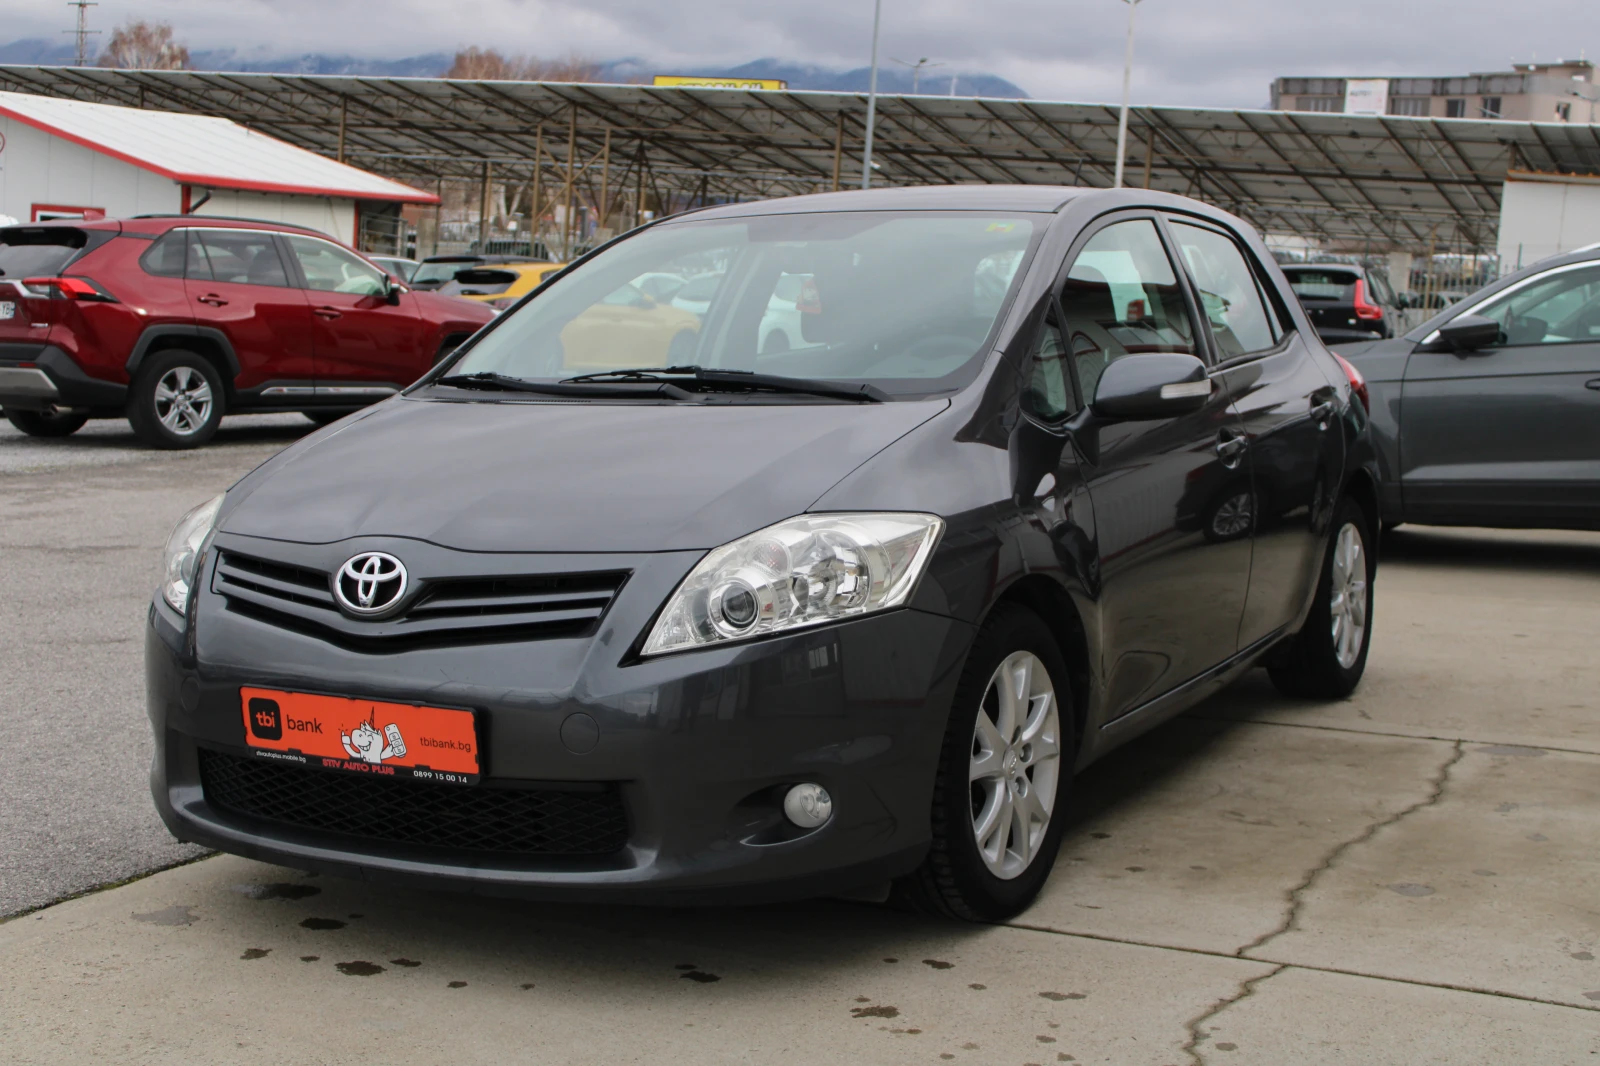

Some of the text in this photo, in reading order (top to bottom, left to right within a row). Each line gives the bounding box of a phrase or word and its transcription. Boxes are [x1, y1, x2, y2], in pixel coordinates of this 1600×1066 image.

[255, 711, 323, 734] tbi bank
[420, 737, 471, 753] tbibank.bg
[322, 758, 395, 775] STIV AUTO PLUS
[413, 770, 468, 783] 0899 15 00 14
